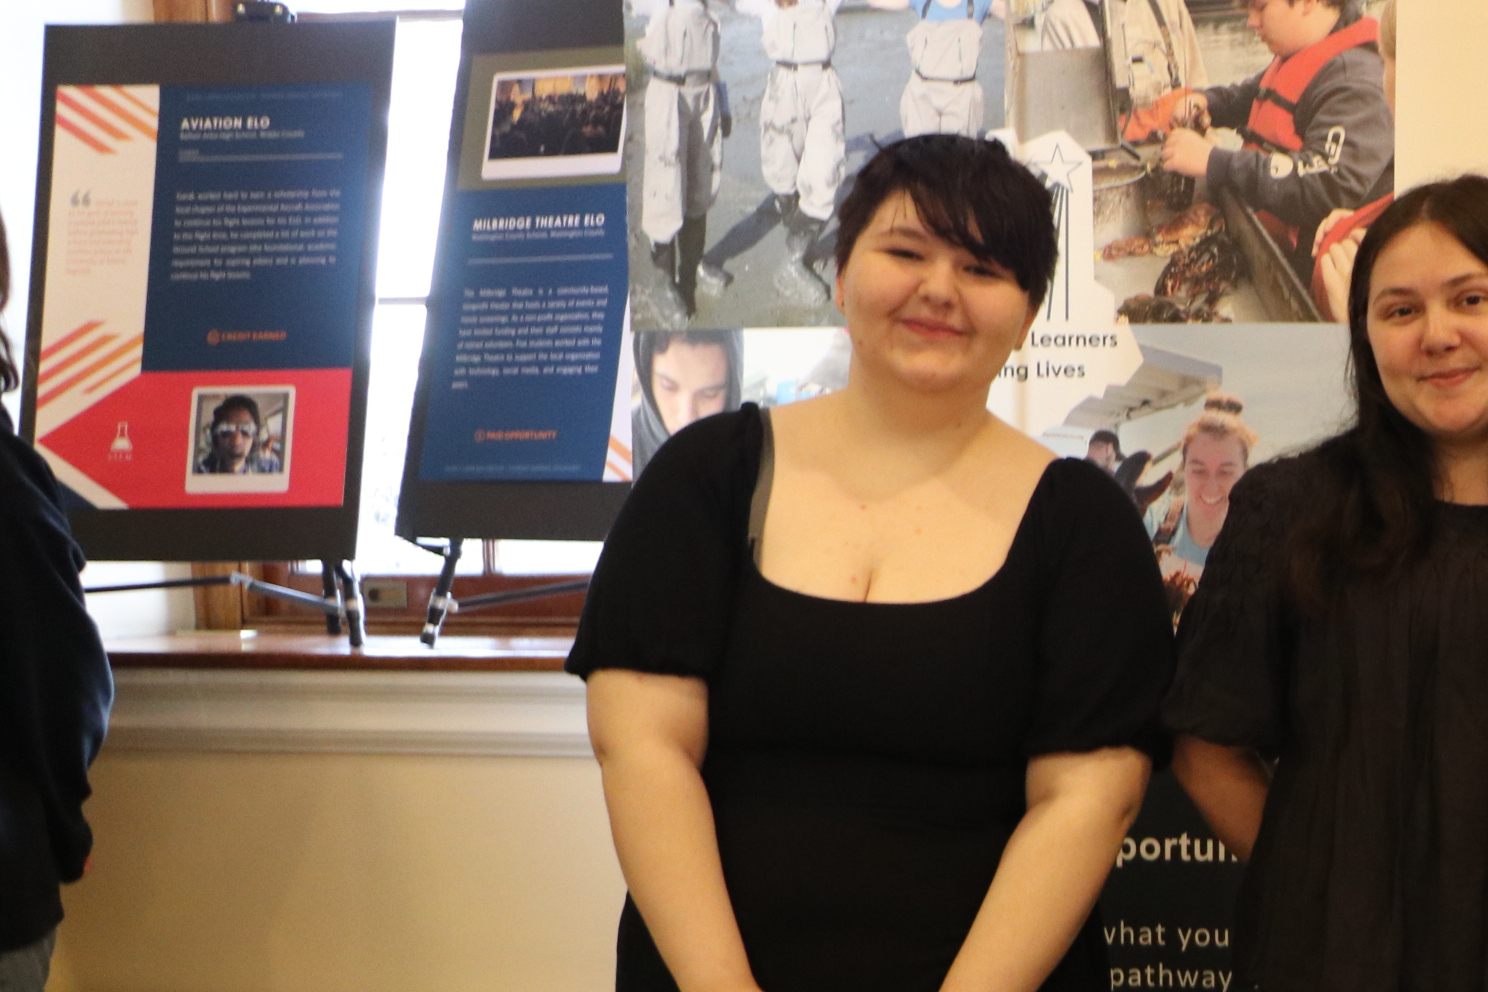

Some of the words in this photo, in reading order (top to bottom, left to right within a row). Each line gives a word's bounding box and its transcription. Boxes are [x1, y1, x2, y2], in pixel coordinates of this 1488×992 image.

[181, 117, 242, 130] AVIATION
[473, 217, 531, 231] MILBRIDGE
[535, 214, 580, 228] THEATRE
[584, 213, 605, 227] ELO
[1031, 330, 1118, 347] Learners
[1036, 360, 1085, 378] Lives
[1177, 926, 1229, 952] you
